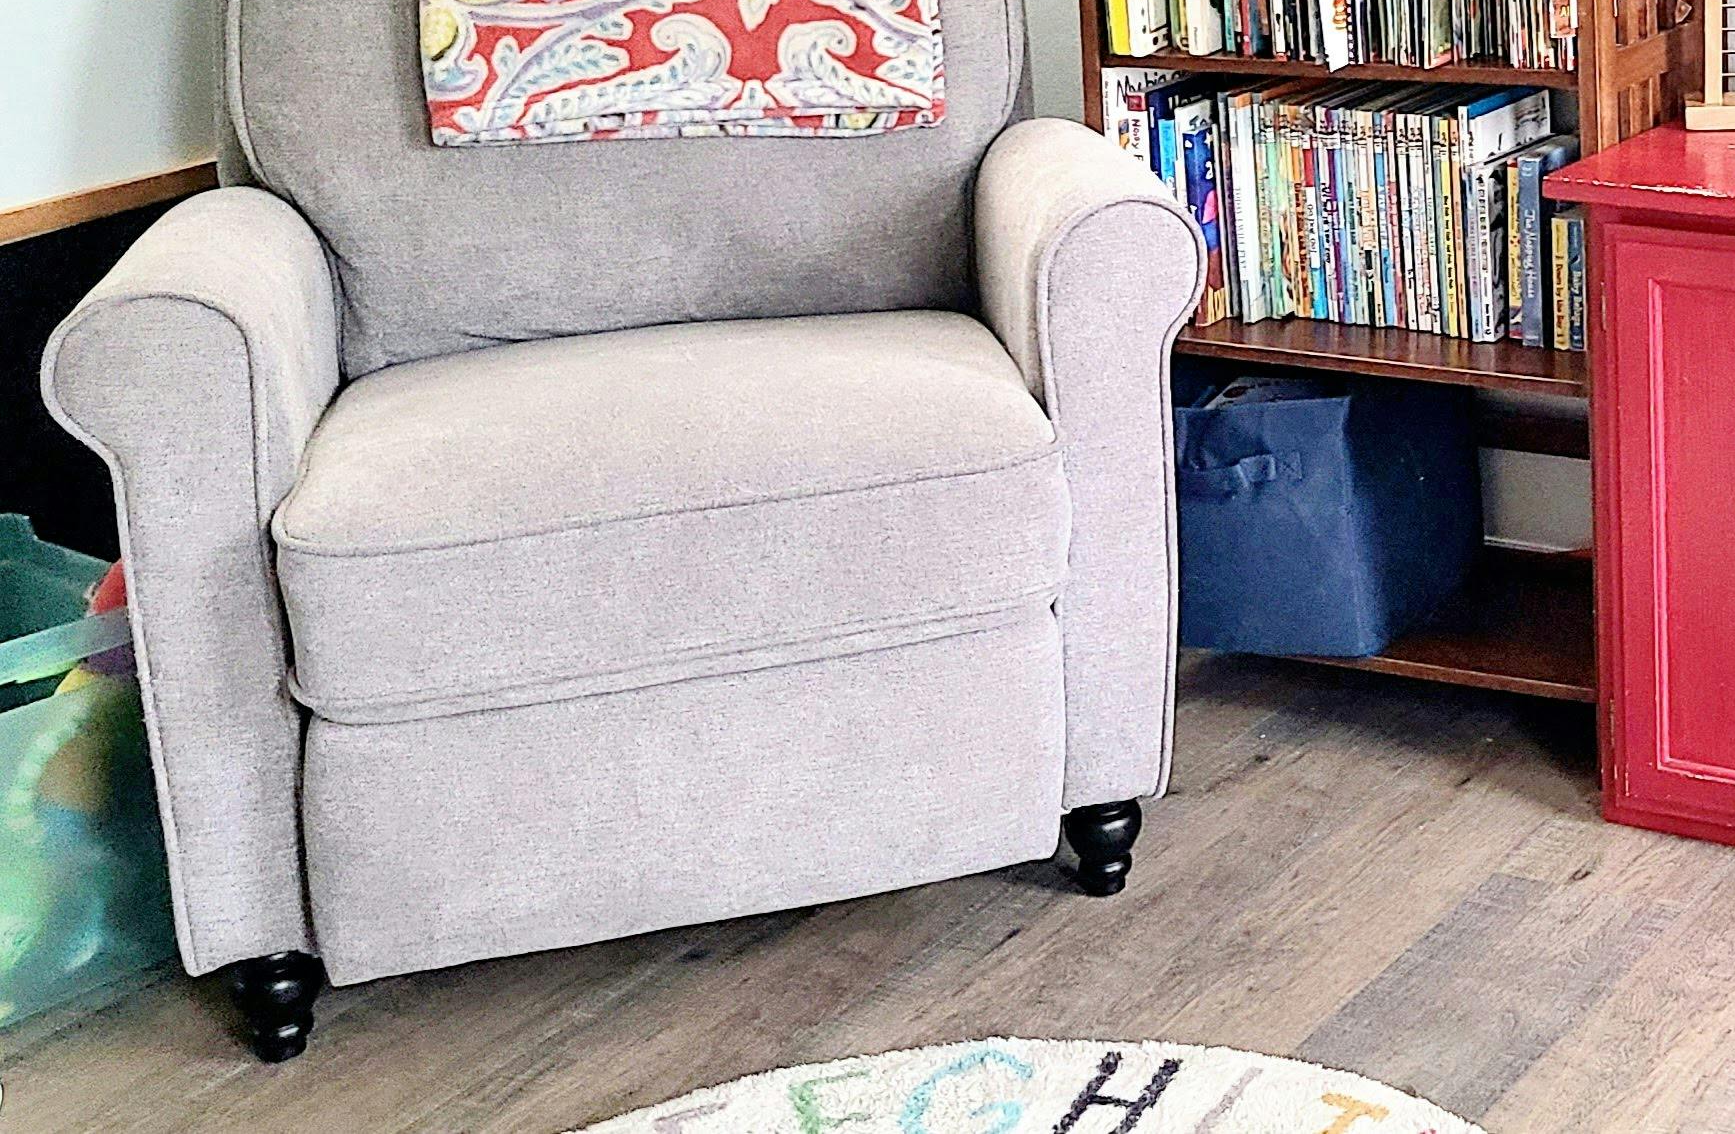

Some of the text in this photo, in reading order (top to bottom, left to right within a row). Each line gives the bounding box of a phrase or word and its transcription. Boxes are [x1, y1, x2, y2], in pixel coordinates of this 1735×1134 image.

[1523, 209, 1538, 298] The Napping House
[1554, 287, 1567, 297] by
[1570, 270, 1582, 295] Baby
